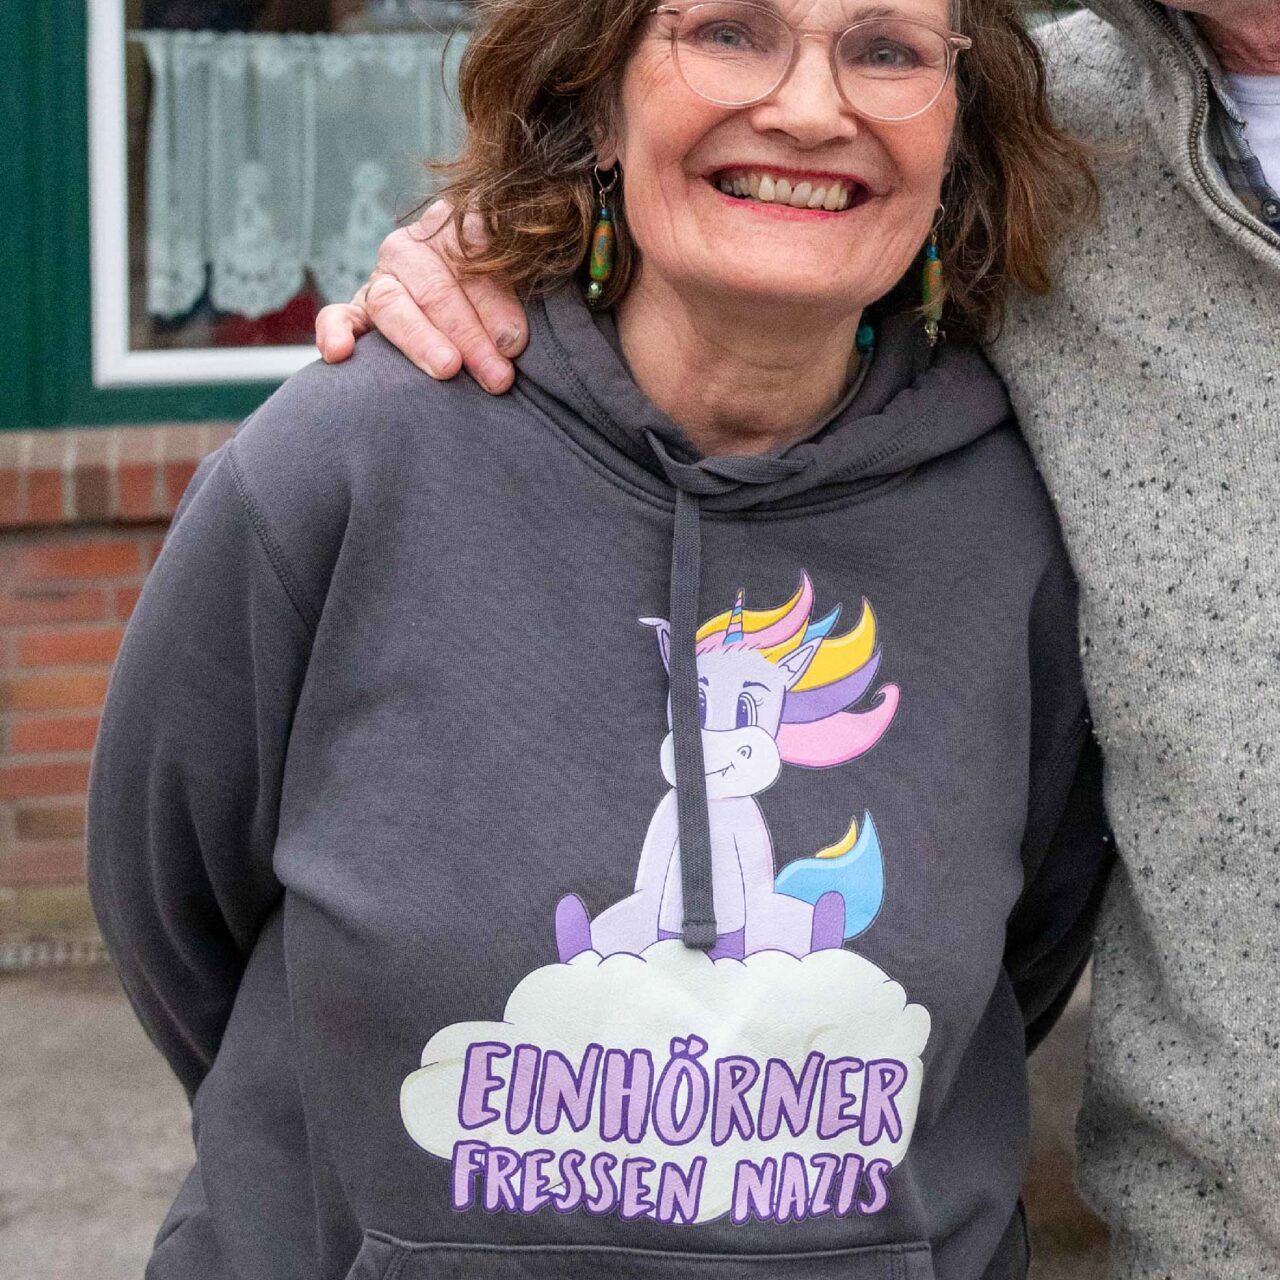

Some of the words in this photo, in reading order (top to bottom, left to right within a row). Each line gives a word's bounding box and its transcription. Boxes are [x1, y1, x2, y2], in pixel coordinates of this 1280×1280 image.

[458, 1034, 908, 1146] EINHÖRNER
[451, 1140, 706, 1224] FRESSEN
[731, 1152, 894, 1224] NAZIS
